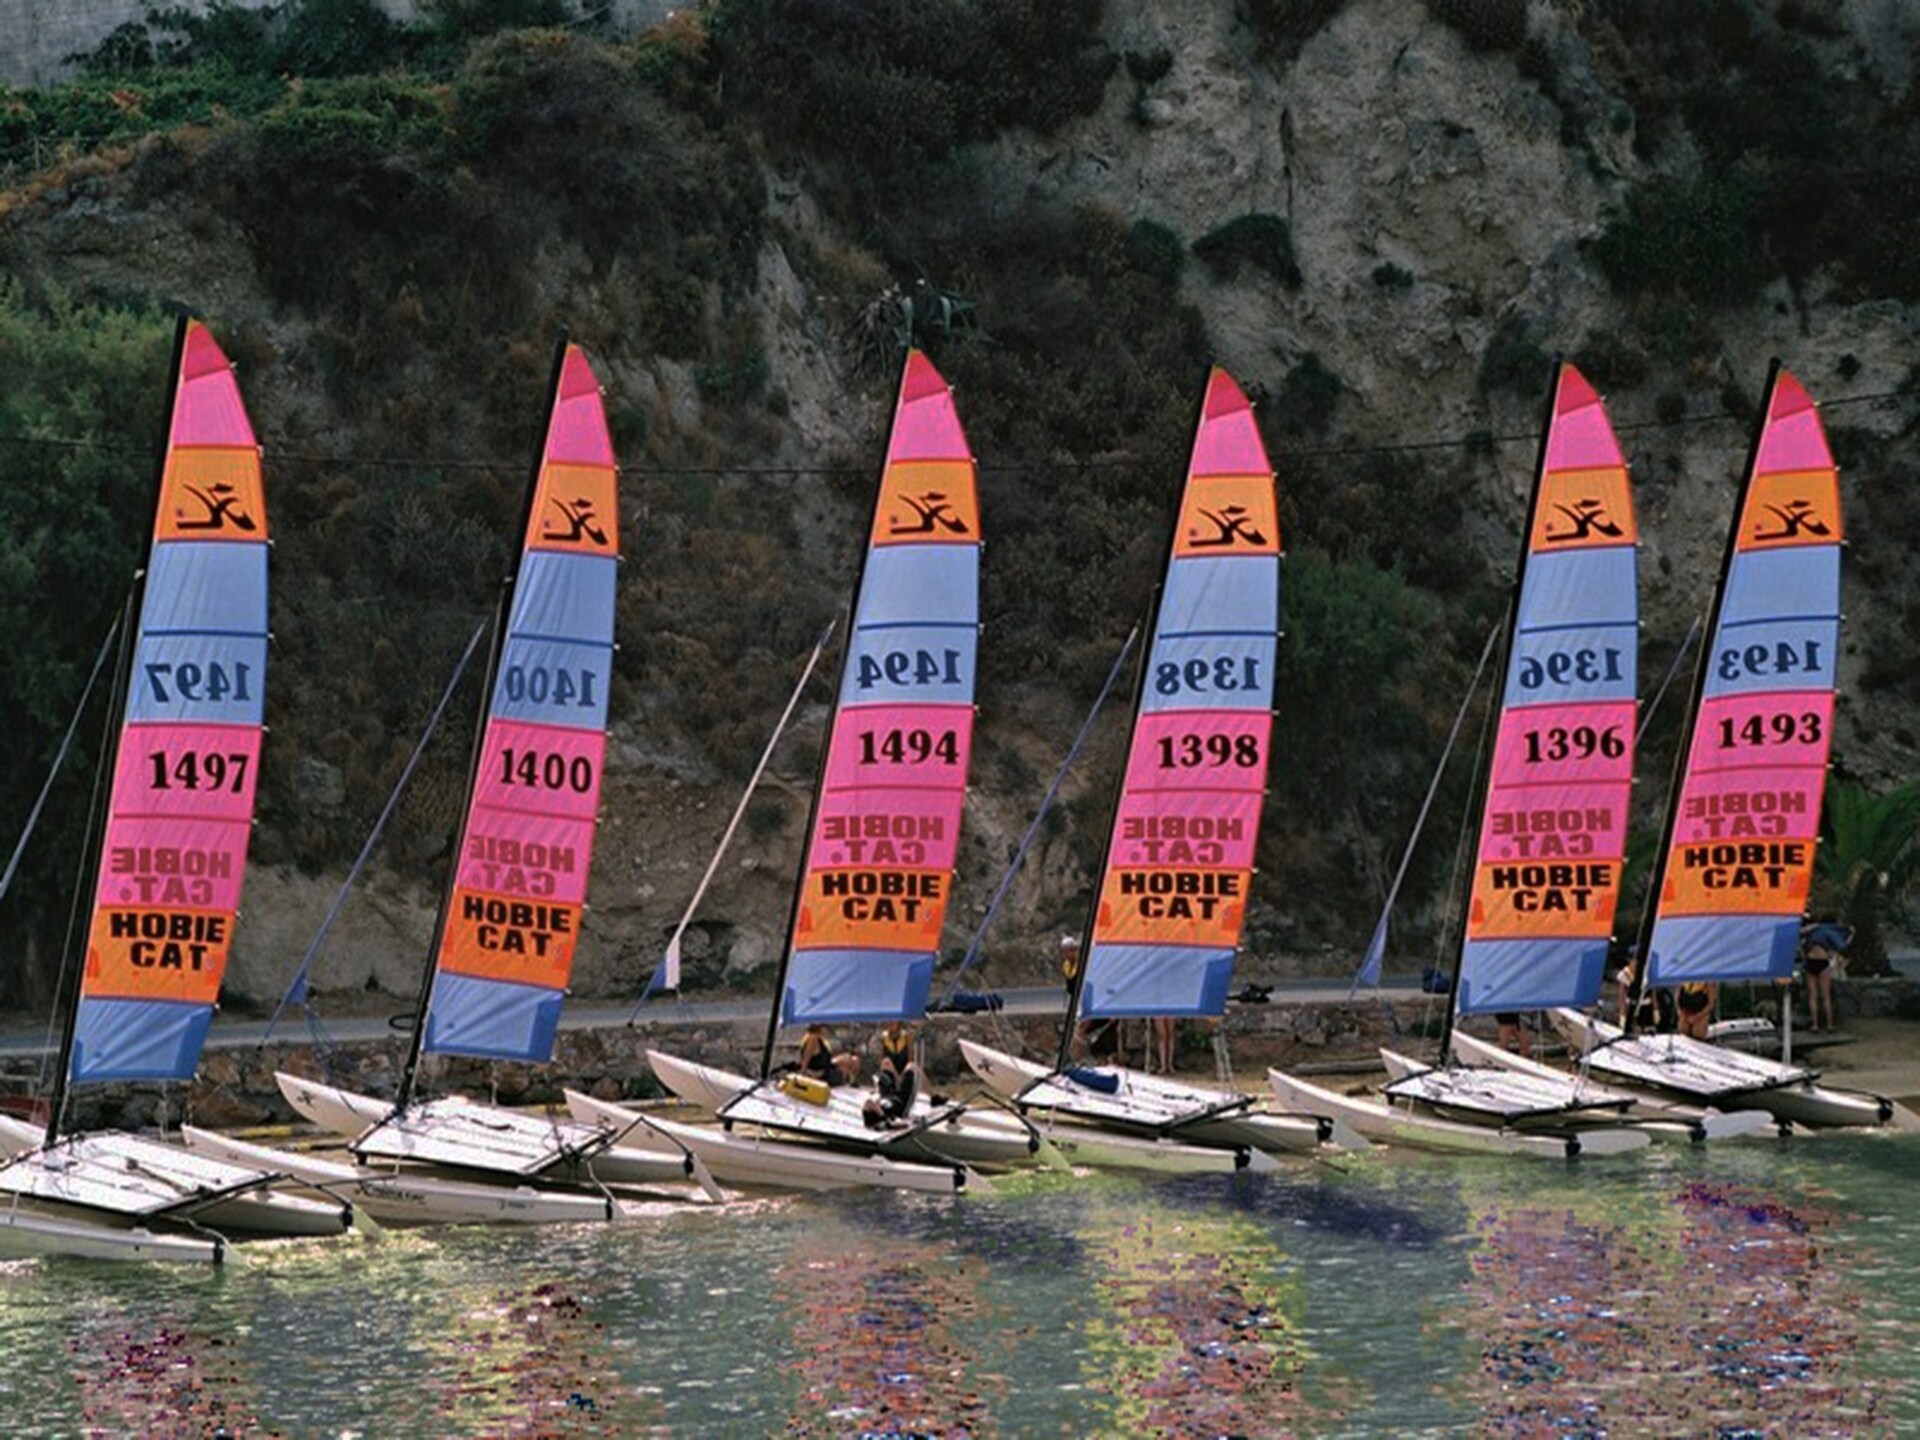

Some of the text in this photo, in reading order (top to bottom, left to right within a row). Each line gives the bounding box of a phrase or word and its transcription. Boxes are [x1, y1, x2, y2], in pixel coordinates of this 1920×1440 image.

[1524, 726, 1625, 763] 1396
[1718, 712, 1821, 748] 1493
[859, 729, 960, 765] 1494
[1157, 734, 1259, 768] 1398
[148, 752, 249, 793] 1497
[500, 749, 592, 793] 1400
[1685, 843, 1805, 868] HOBIE
[822, 872, 941, 897] HOBIE
[1120, 873, 1239, 895] HOBIE
[1492, 864, 1611, 888] HOBIE
[1703, 867, 1786, 889] CAT
[463, 896, 571, 932] HOBIE
[843, 897, 921, 922] CAT
[1139, 897, 1219, 920] CAT
[1512, 889, 1592, 912] CAT
[110, 913, 226, 944] HOBIE
[477, 926, 552, 956] CAT
[130, 942, 208, 970] CAT
